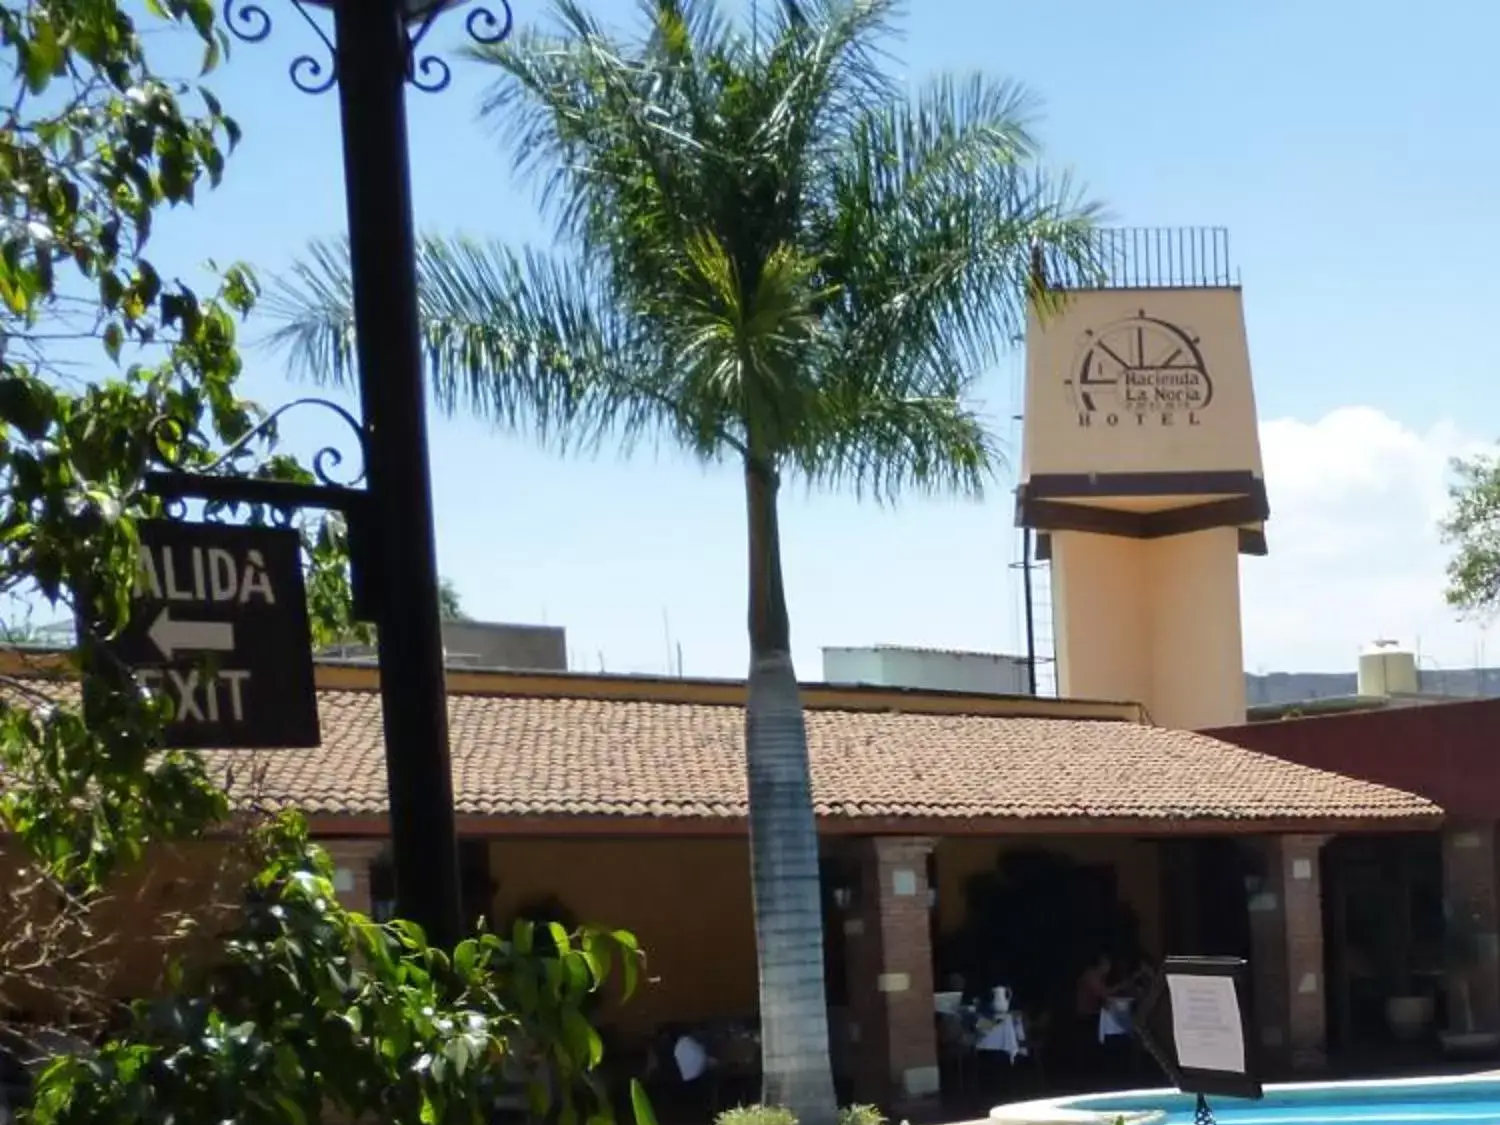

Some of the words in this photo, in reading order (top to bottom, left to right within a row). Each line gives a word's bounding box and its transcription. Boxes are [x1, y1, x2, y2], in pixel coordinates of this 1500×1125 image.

[1126, 371, 1200, 385] Hacienda
[1126, 387, 1148, 401] La
[1155, 386, 1201, 401] Noria
[1078, 411, 1201, 427] HOTEL
[132, 544, 276, 605] ALIDA
